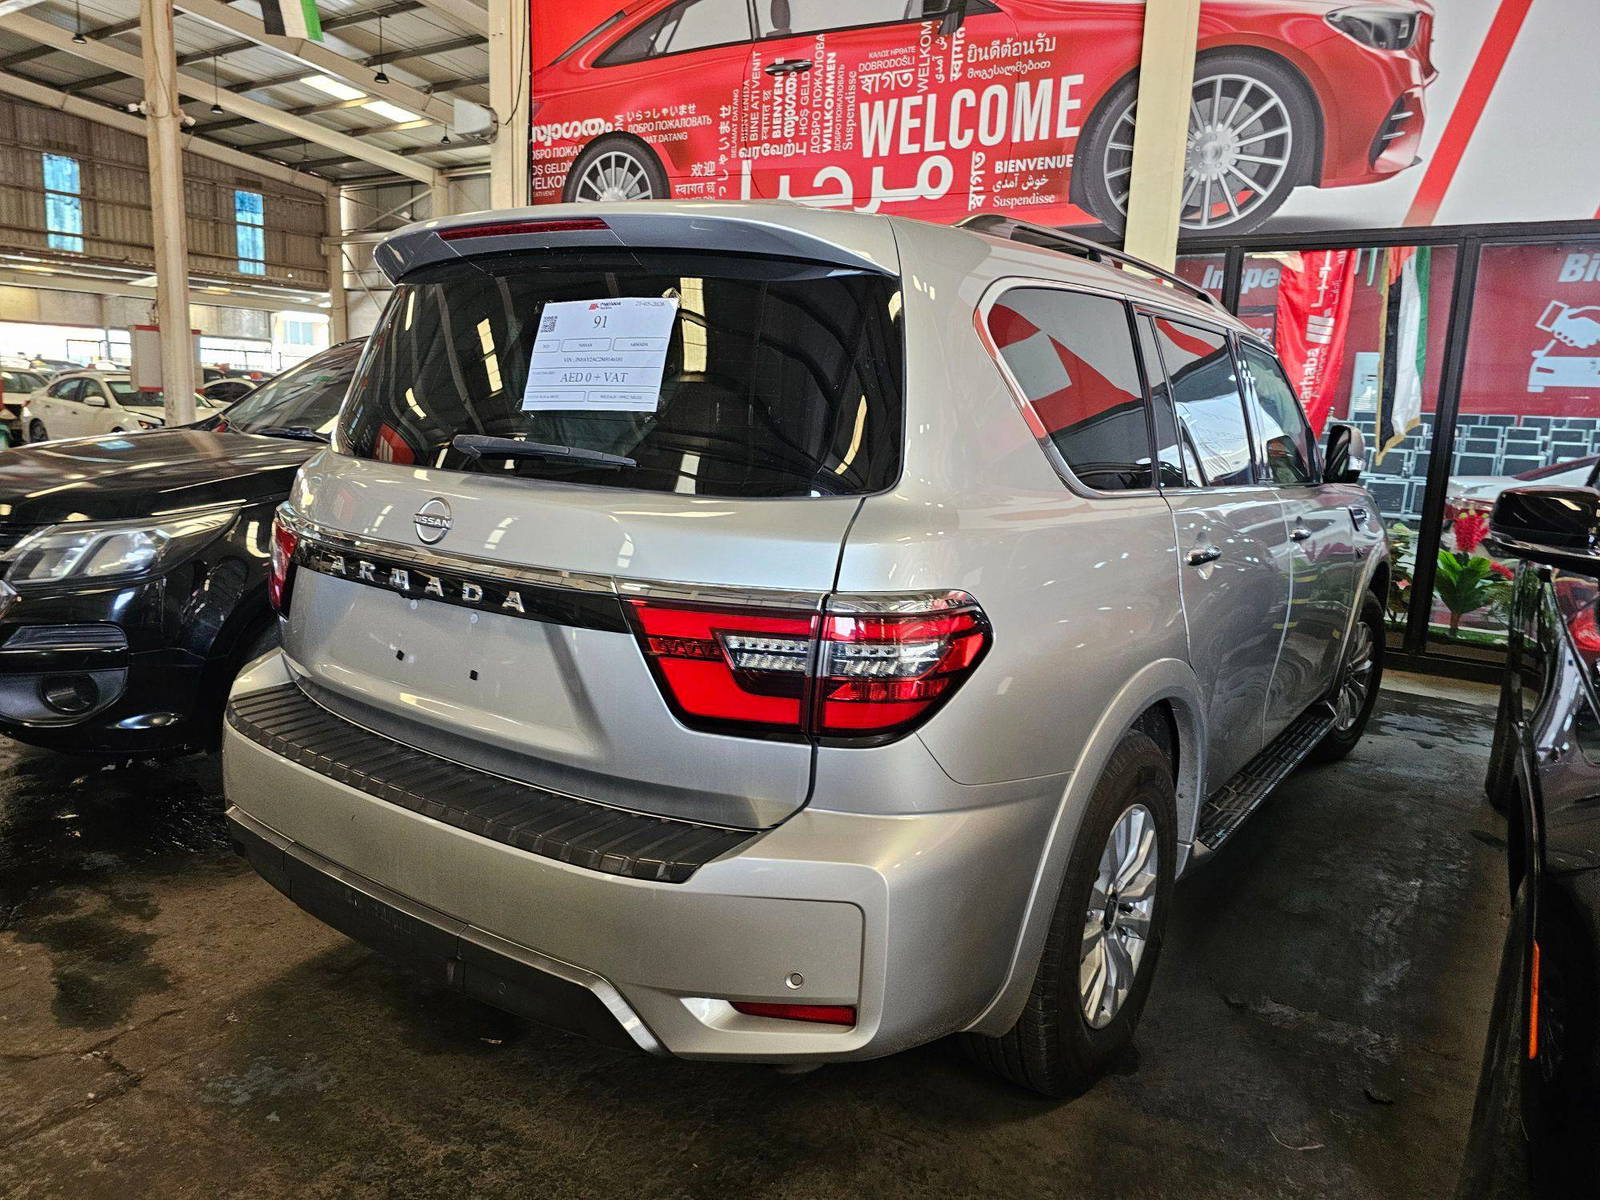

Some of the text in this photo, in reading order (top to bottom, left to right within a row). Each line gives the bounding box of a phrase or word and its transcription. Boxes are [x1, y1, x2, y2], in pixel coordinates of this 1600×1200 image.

[917, 21, 933, 93] WELKOM
[966, 32, 1057, 63] ยินดีต้อนรับ
[752, 50, 762, 88] VENIT
[858, 56, 915, 73] DOBRODOŠLI
[772, 57, 785, 139] BIENVENE
[799, 71, 811, 105] GELD
[823, 52, 837, 153] WILLKOMMEN
[626, 103, 697, 121] いらっしゃいませ
[655, 115, 713, 131] ПОЖАЛОВАТЬ
[843, 71, 857, 150] Suspendisse
[859, 74, 1085, 159] WELCOME
[658, 132, 688, 143] DATANG
[749, 111, 759, 142] BINE
[810, 111, 822, 154] ДОБРО
[690, 160, 716, 177] 欢迎
[994, 154, 1074, 175] BIENVENUE
[992, 194, 1057, 209] Suspendisse
[1202, 264, 1280, 294] Inpe
[593, 315, 608, 329] 91
[560, 372, 584, 383] AED
[603, 372, 629, 383] VAT
[329, 554, 526, 613] ARMADA
